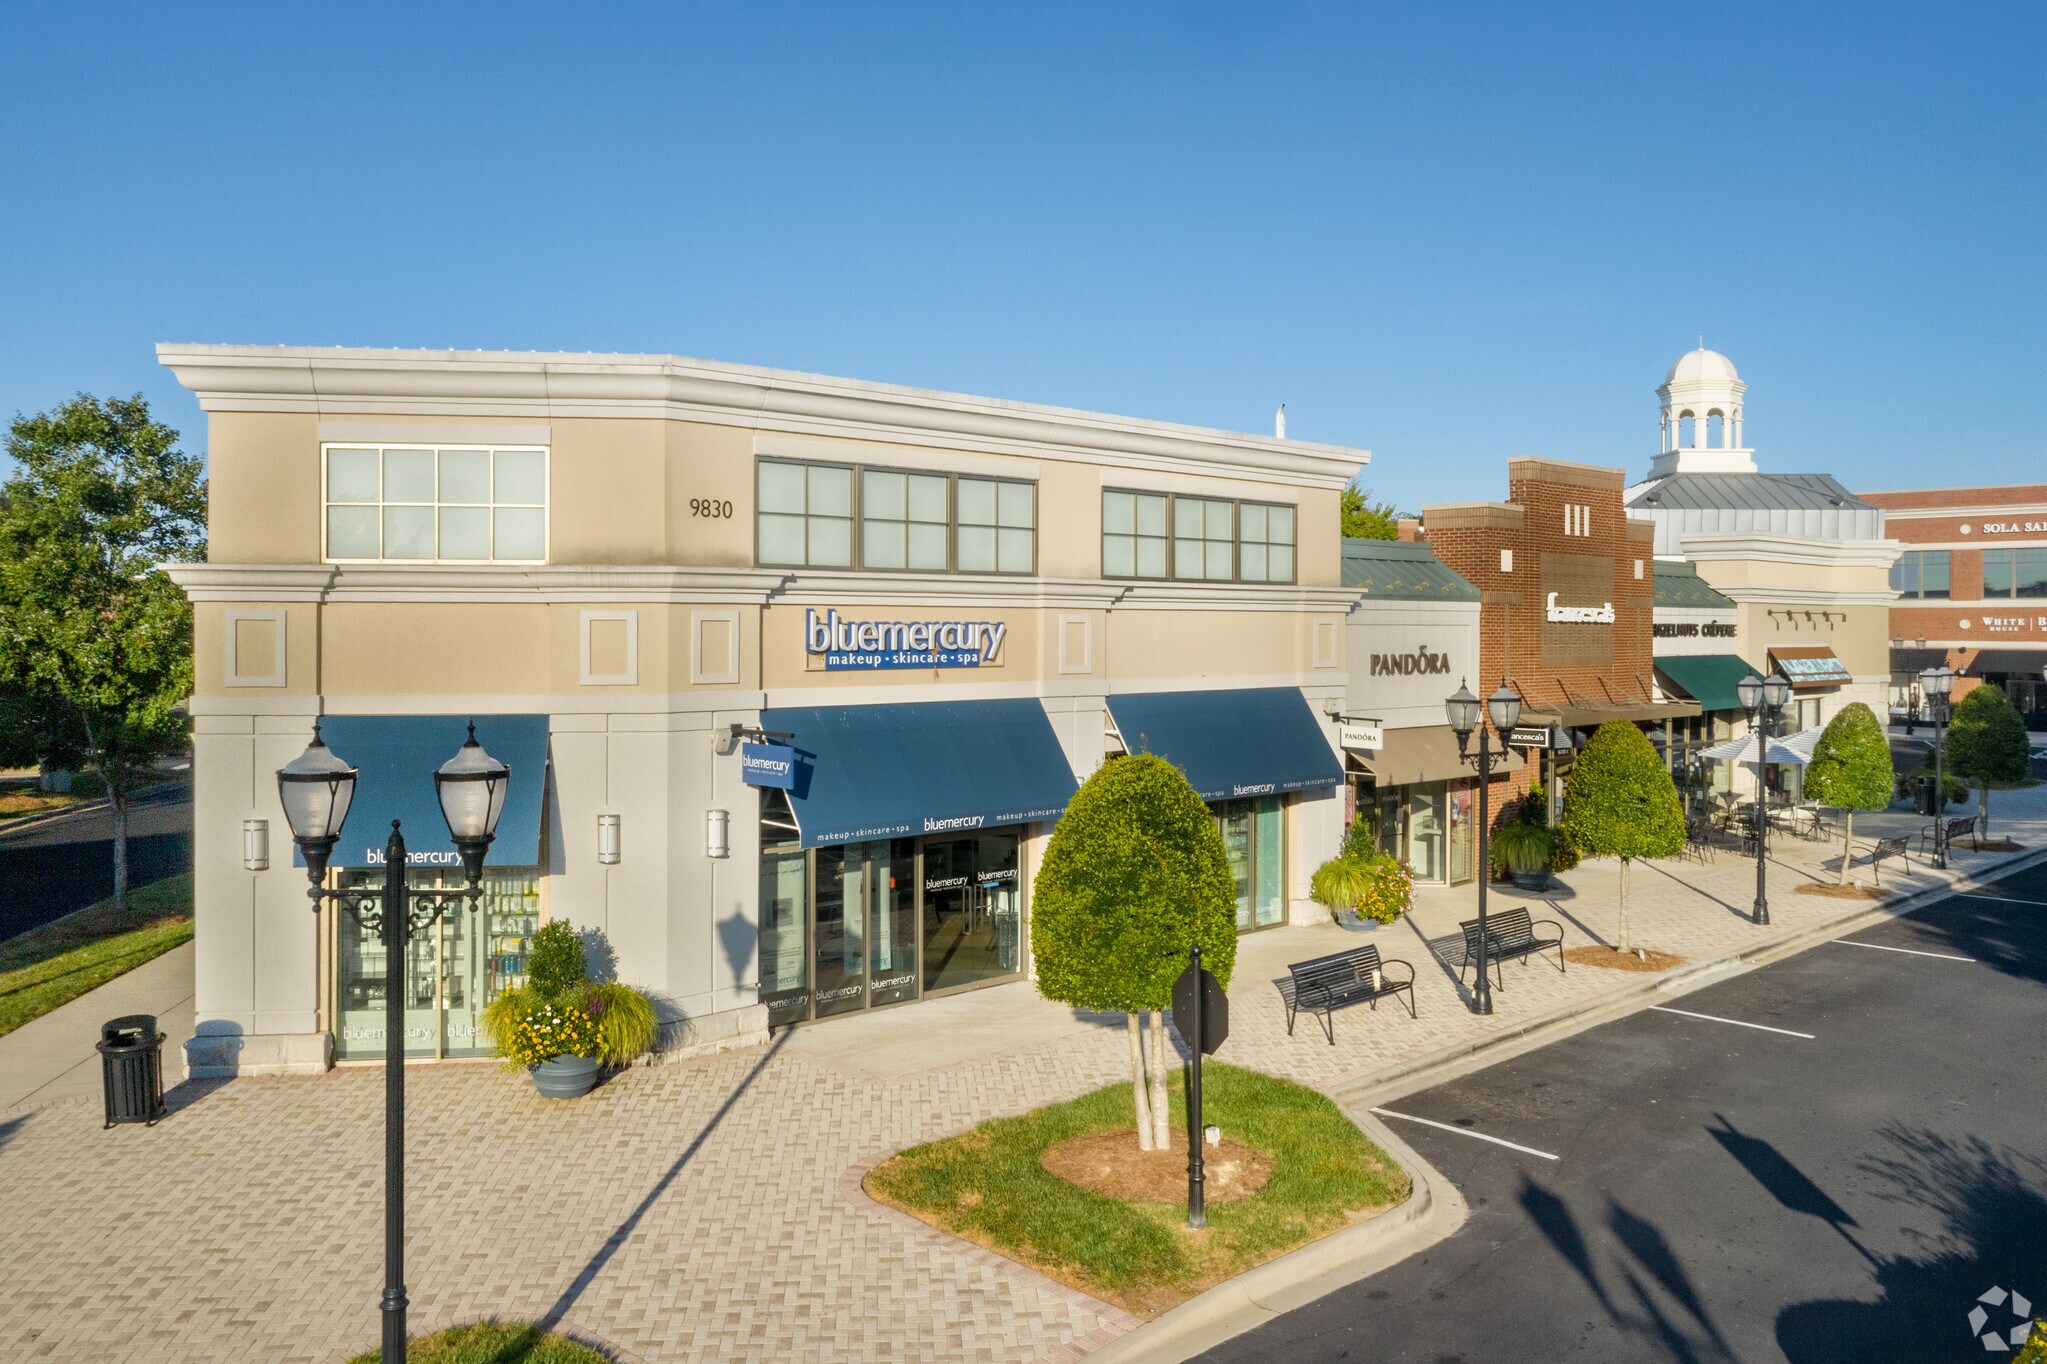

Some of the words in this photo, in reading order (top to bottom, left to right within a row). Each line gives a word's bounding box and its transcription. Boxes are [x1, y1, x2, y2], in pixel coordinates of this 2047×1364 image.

[690, 498, 733, 519] 9830
[1982, 523, 2020, 533] SOLA
[1982, 616, 2025, 626] WHITE
[806, 608, 1005, 662] bluemercury
[829, 653, 882, 667] makeup
[892, 651, 948, 664] skincare
[957, 652, 979, 666] spa
[1510, 733, 1545, 741] ancesca's
[743, 754, 790, 775] bluemercury
[1214, 789, 1225, 798] spa
[1233, 782, 1276, 796] bluemercury
[996, 812, 1023, 821] makeup
[1028, 807, 1057, 817] skincare
[924, 815, 985, 831] bluemercury
[817, 831, 850, 842] makeup
[855, 826, 891, 837] skincare
[896, 824, 910, 834] spa
[367, 849, 462, 866] blumercury
[977, 868, 1018, 881] bluemercury
[926, 876, 969, 889] bluemercury
[871, 974, 916, 989] bluemercury
[816, 984, 864, 1000] bluemercury
